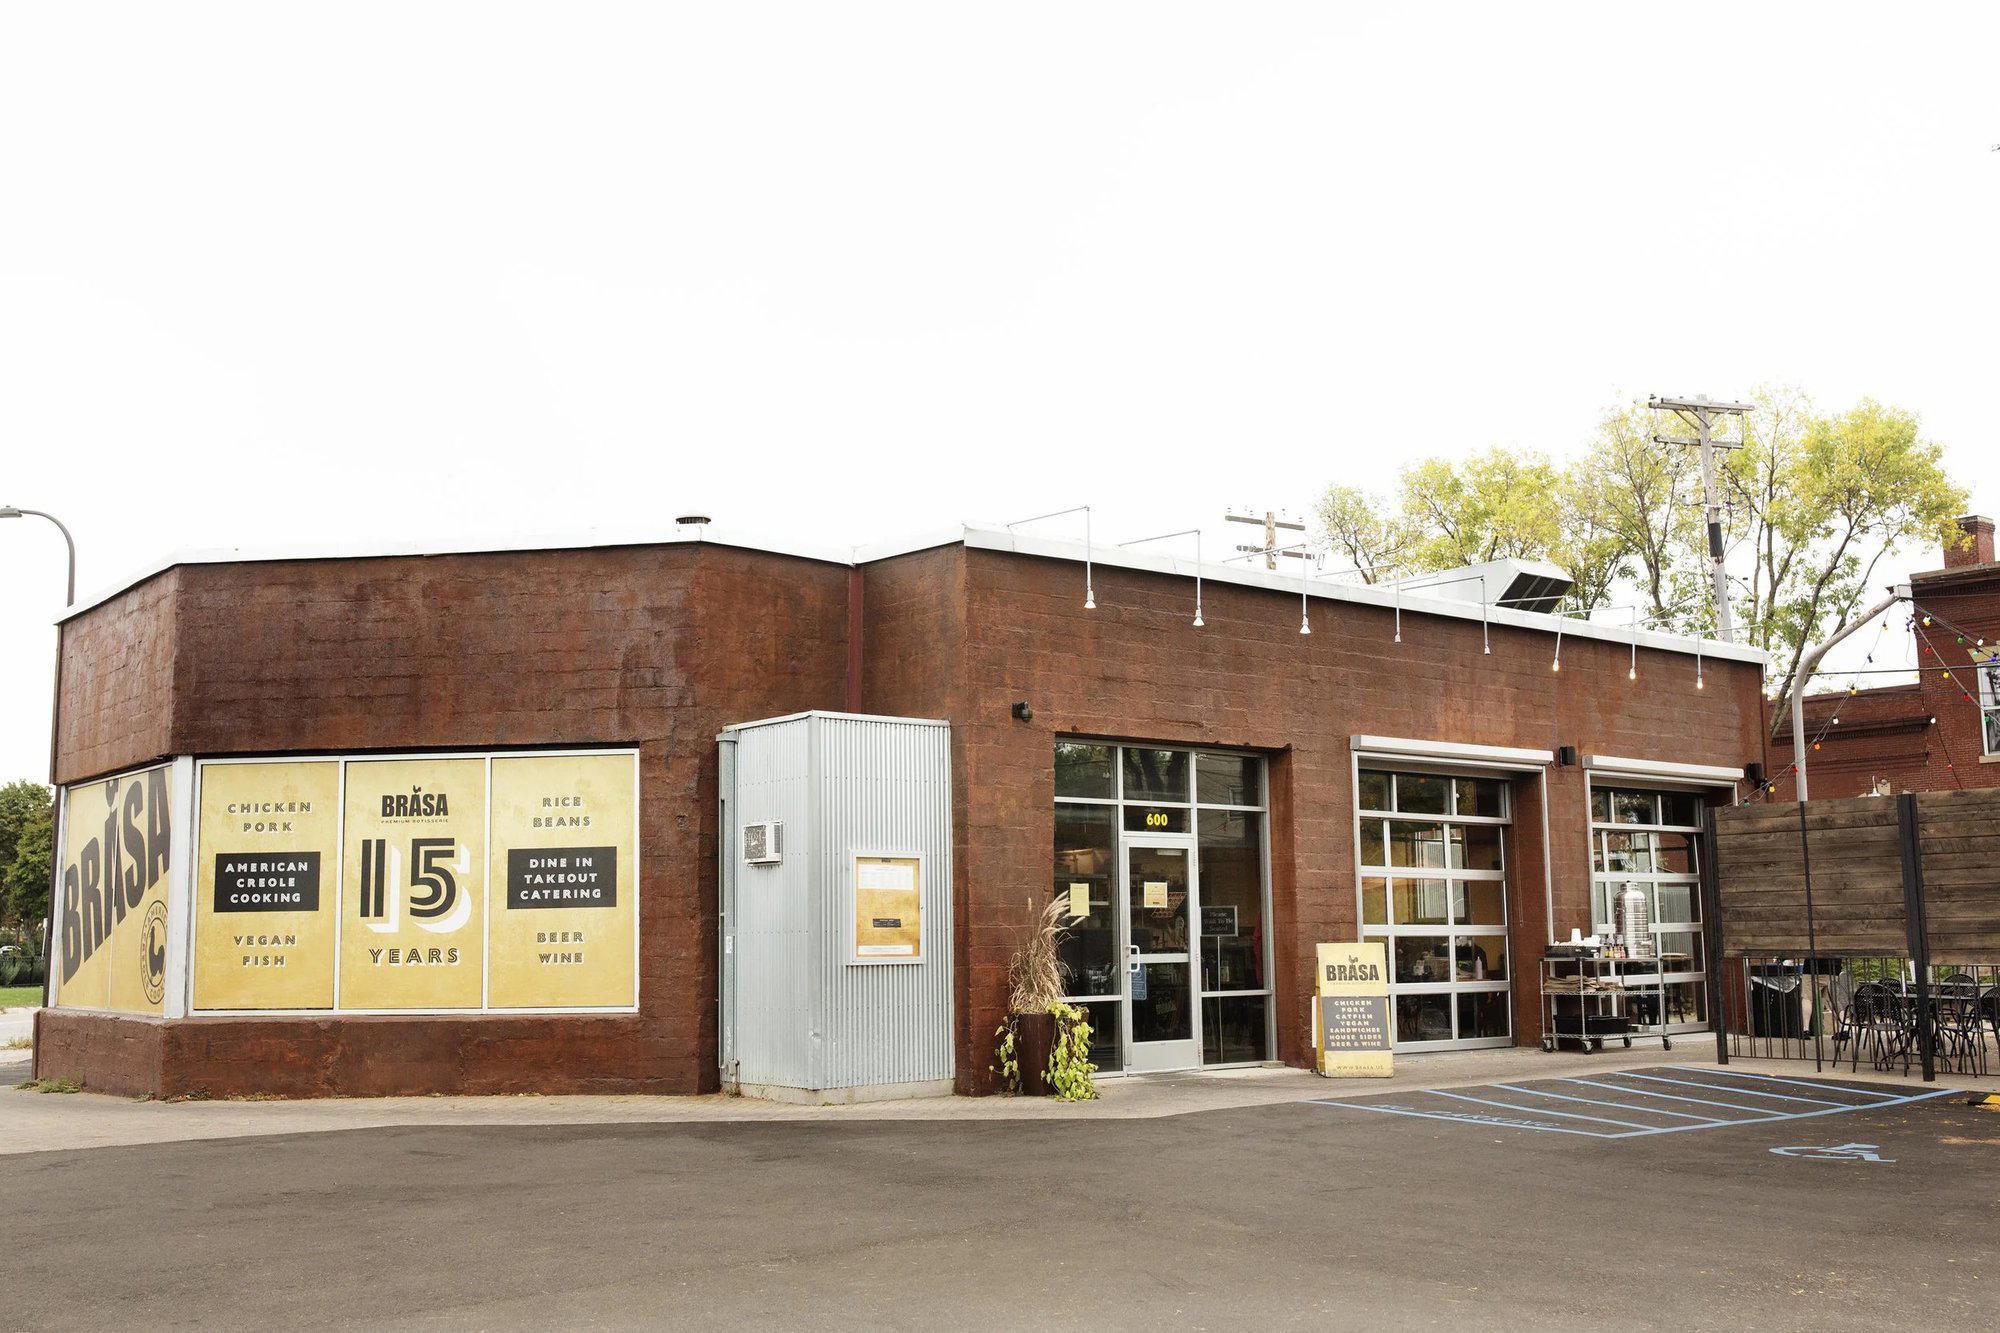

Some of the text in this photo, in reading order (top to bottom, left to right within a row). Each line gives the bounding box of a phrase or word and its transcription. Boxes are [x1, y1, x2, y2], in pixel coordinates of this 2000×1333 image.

[542, 797, 583, 807] RICE
[227, 802, 312, 814] CHICKEN
[533, 816, 591, 828] BEANS
[1146, 813, 1169, 826] 600
[243, 821, 294, 833] PORK
[225, 862, 308, 873] AMERICAN
[529, 857, 593, 868] DINE IN
[236, 877, 296, 888] CREOLE
[360, 838, 459, 919] 15
[524, 873, 598, 884] TAKEOUT
[230, 892, 301, 904] COOKING
[520, 888, 601, 900] CATERING
[233, 935, 296, 946] VEGAN
[537, 932, 584, 942] BEER
[242, 956, 286, 967] FISH
[369, 948, 459, 965] YEARS
[539, 953, 584, 963] WINE
